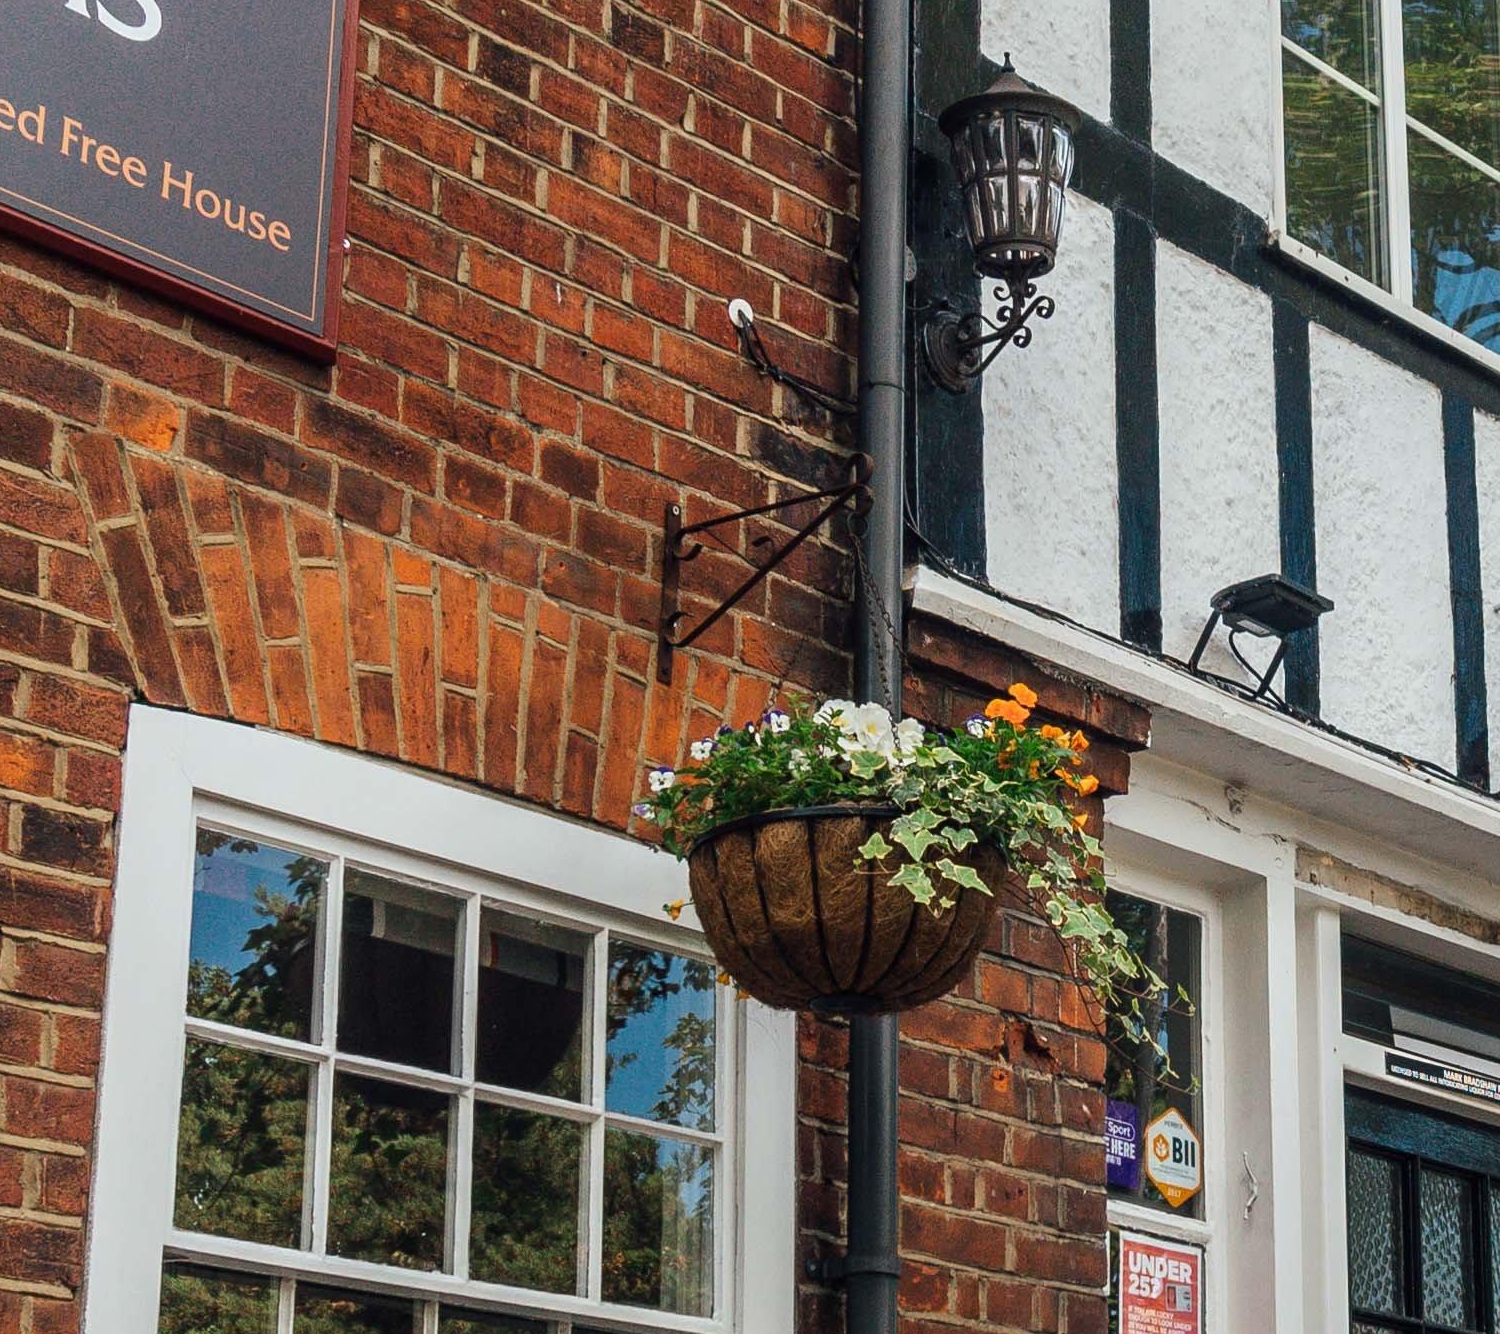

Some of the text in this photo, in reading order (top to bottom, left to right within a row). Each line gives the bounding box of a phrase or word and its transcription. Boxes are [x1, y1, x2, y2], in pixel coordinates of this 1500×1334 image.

[60, 119, 148, 188] Free
[161, 158, 293, 251] House
[1108, 1122, 1131, 1138] Sport
[1110, 1138, 1136, 1160] HERE
[1172, 1137, 1196, 1168] BII
[1128, 1251, 1192, 1284] UNDER
